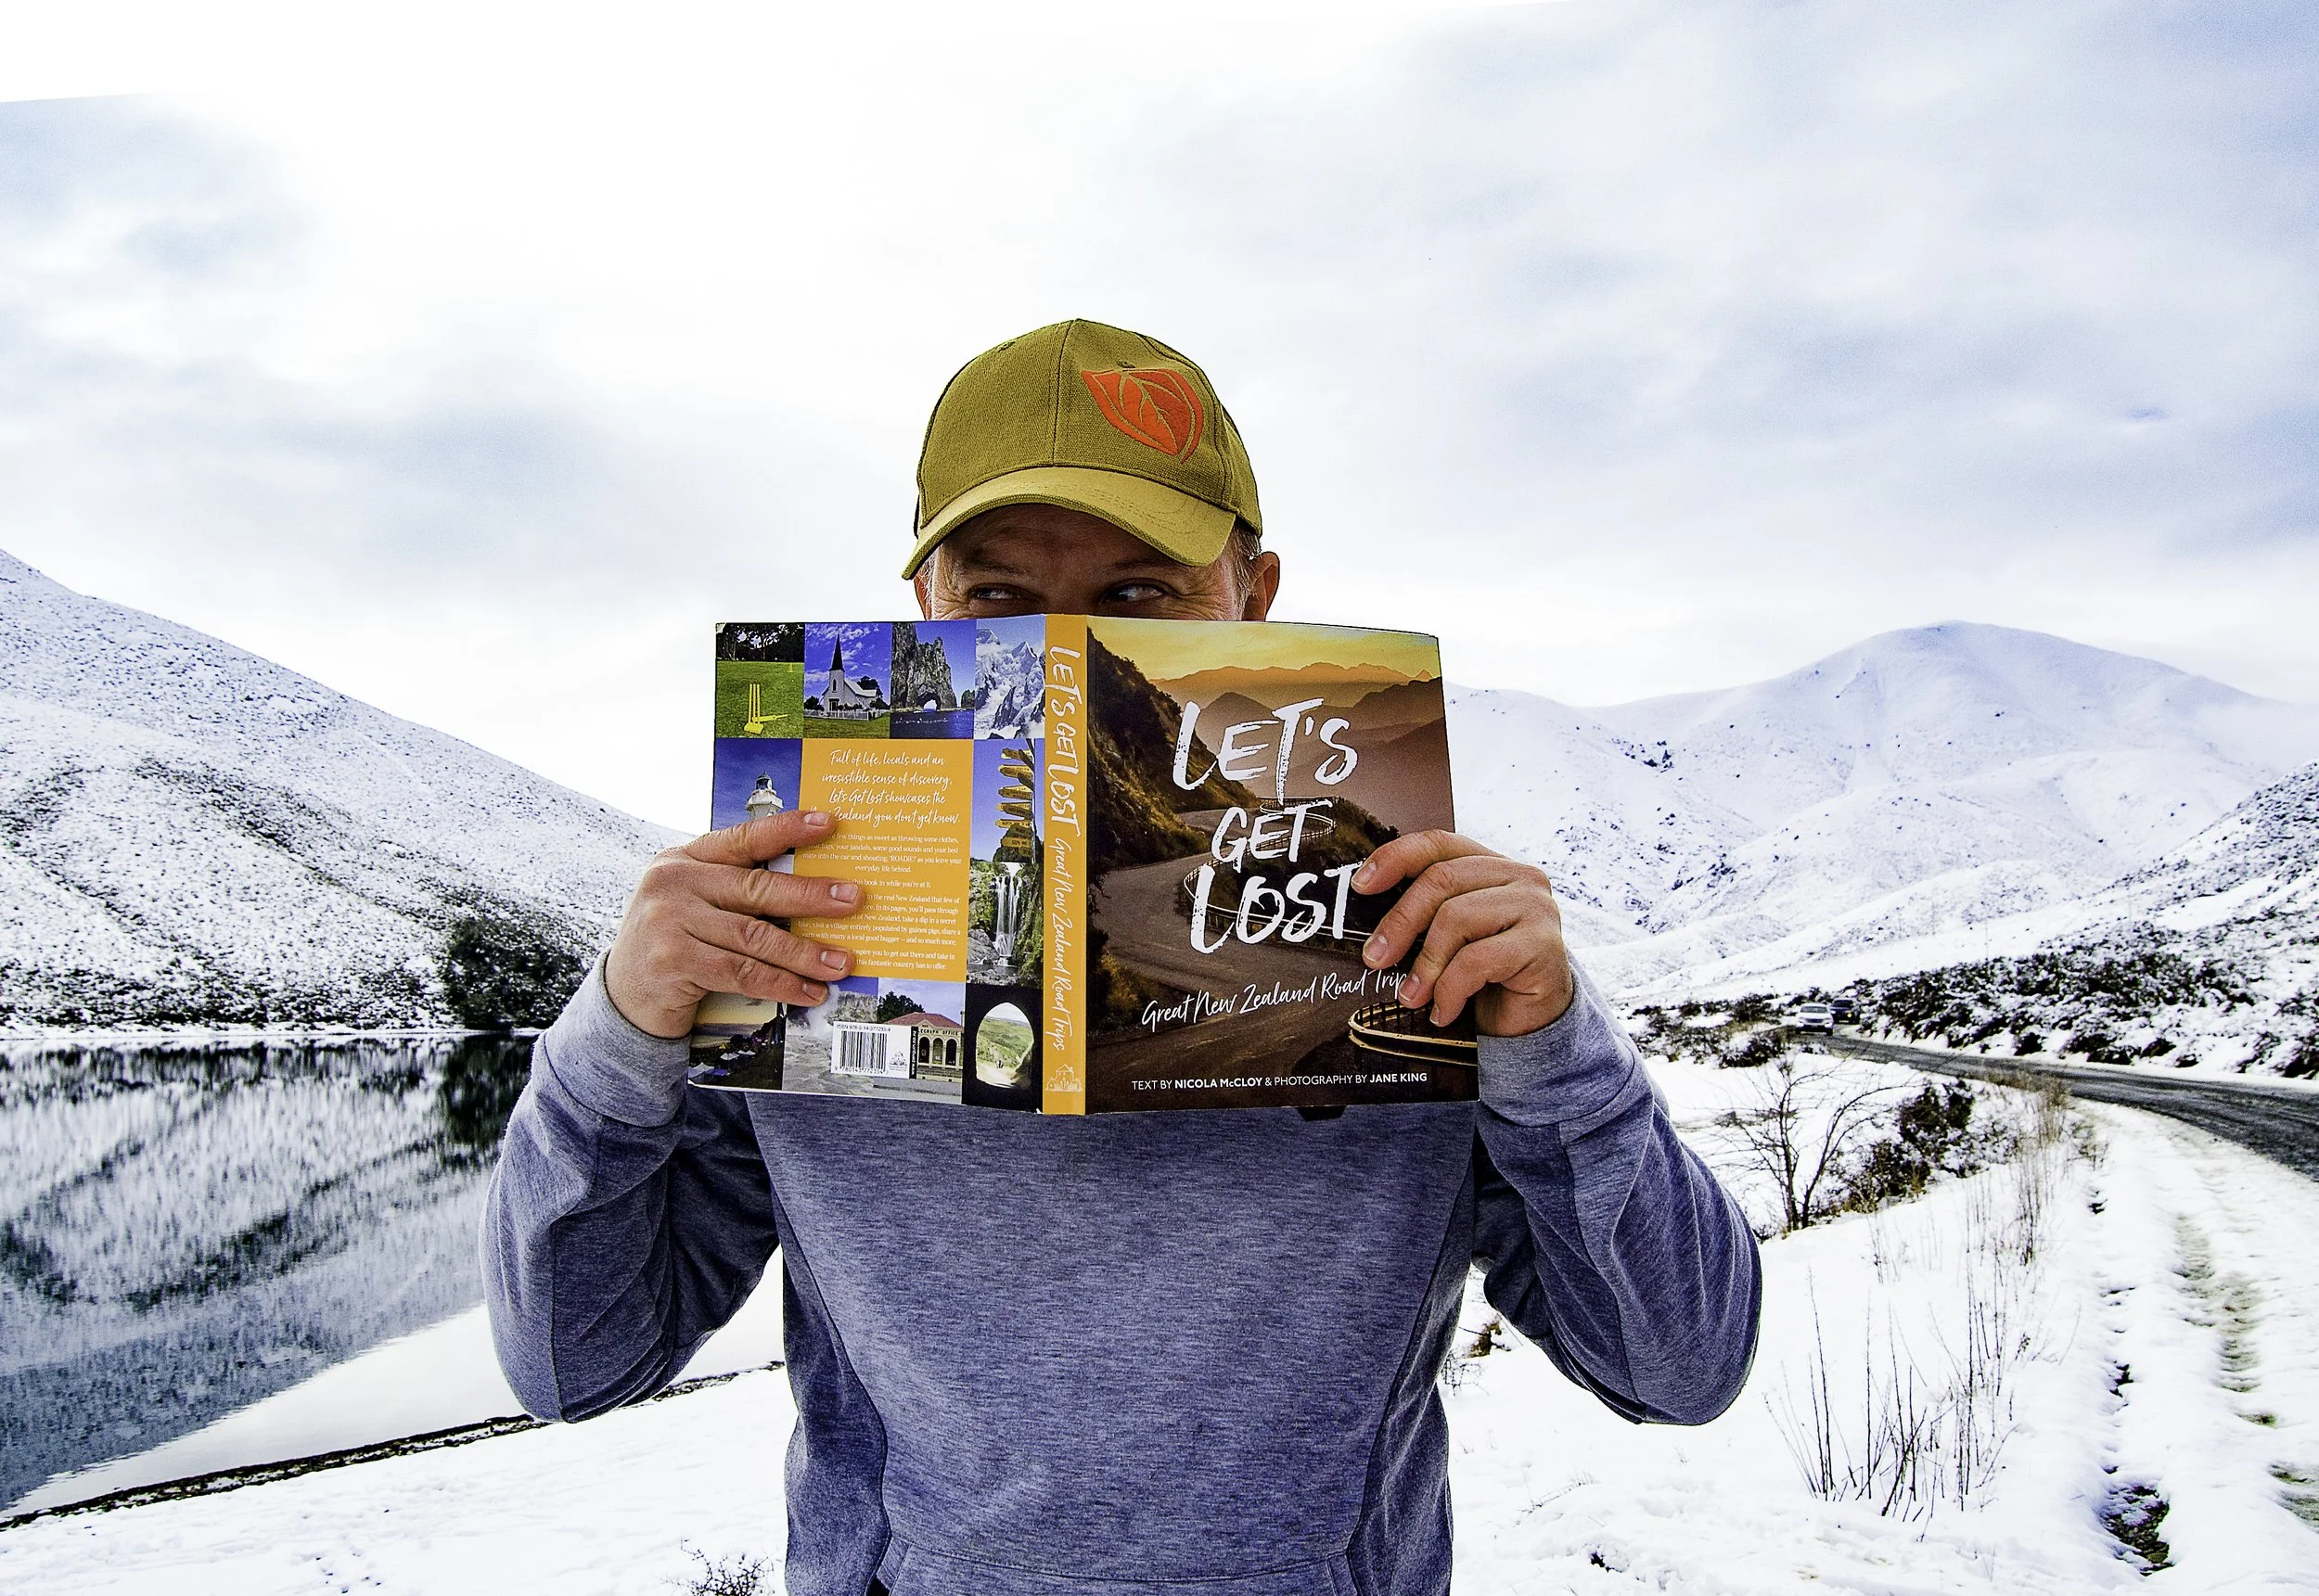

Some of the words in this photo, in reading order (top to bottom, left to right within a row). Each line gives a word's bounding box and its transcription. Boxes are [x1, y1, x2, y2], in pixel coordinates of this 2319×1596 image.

[1045, 646, 1083, 717] LET'S
[1053, 721, 1079, 769] GET
[1172, 697, 1358, 805] LET'S
[830, 748, 852, 765] Full
[852, 752, 863, 767] of
[863, 751, 881, 767] life,
[883, 751, 910, 766] locals
[911, 752, 931, 767] and
[931, 757, 945, 766] an
[821, 769, 870, 784] irresistible
[872, 775, 897, 785] sense
[898, 772, 909, 786] of
[909, 772, 953, 791] discovery,
[828, 787, 848, 804] Let's
[848, 788, 868, 807] Get
[865, 788, 887, 805] Lost
[884, 790, 931, 805] showcases
[931, 790, 946, 805] the
[1047, 763, 1081, 837] LOST
[872, 813, 892, 828] you
[916, 809, 934, 829] yet
[932, 809, 961, 824] know.
[848, 834, 865, 842] things
[898, 835, 923, 843] throwing
[1211, 799, 1334, 873] GET
[854, 864, 880, 873] everyday
[1049, 837, 1072, 879] Great
[909, 895, 930, 903] Zealand
[1052, 877, 1072, 914] New
[1190, 859, 1366, 953] LOST
[903, 914, 915, 923] take
[919, 915, 929, 925] dip
[936, 907, 959, 915] through
[830, 922, 849, 930] village
[850, 923, 871, 931] entirely
[872, 925, 900, 933] populated
[879, 935, 900, 943] bugger
[1051, 913, 1072, 972] Zealand
[867, 959, 892, 967] fantastic
[892, 960, 915, 969] country
[916, 961, 926, 969] has
[1051, 969, 1072, 1013] Road
[1141, 992, 1196, 1032] Great
[1193, 990, 1239, 1023] New
[1239, 976, 1316, 1015] Zealand
[1320, 968, 1369, 1001] Road
[1045, 1013, 1072, 1051] Trips
[1132, 1079, 1157, 1090] TEXT
[1160, 1079, 1172, 1090] BY
[1174, 1079, 1218, 1089] NICOLA
[1220, 1077, 1262, 1088] McCLOY
[1264, 1077, 1272, 1086] &
[1275, 1075, 1353, 1087] PHOTOGRAPHY
[1355, 1074, 1367, 1083] BY
[1369, 1073, 1398, 1083] JANE
[1400, 1072, 1428, 1083] KING
